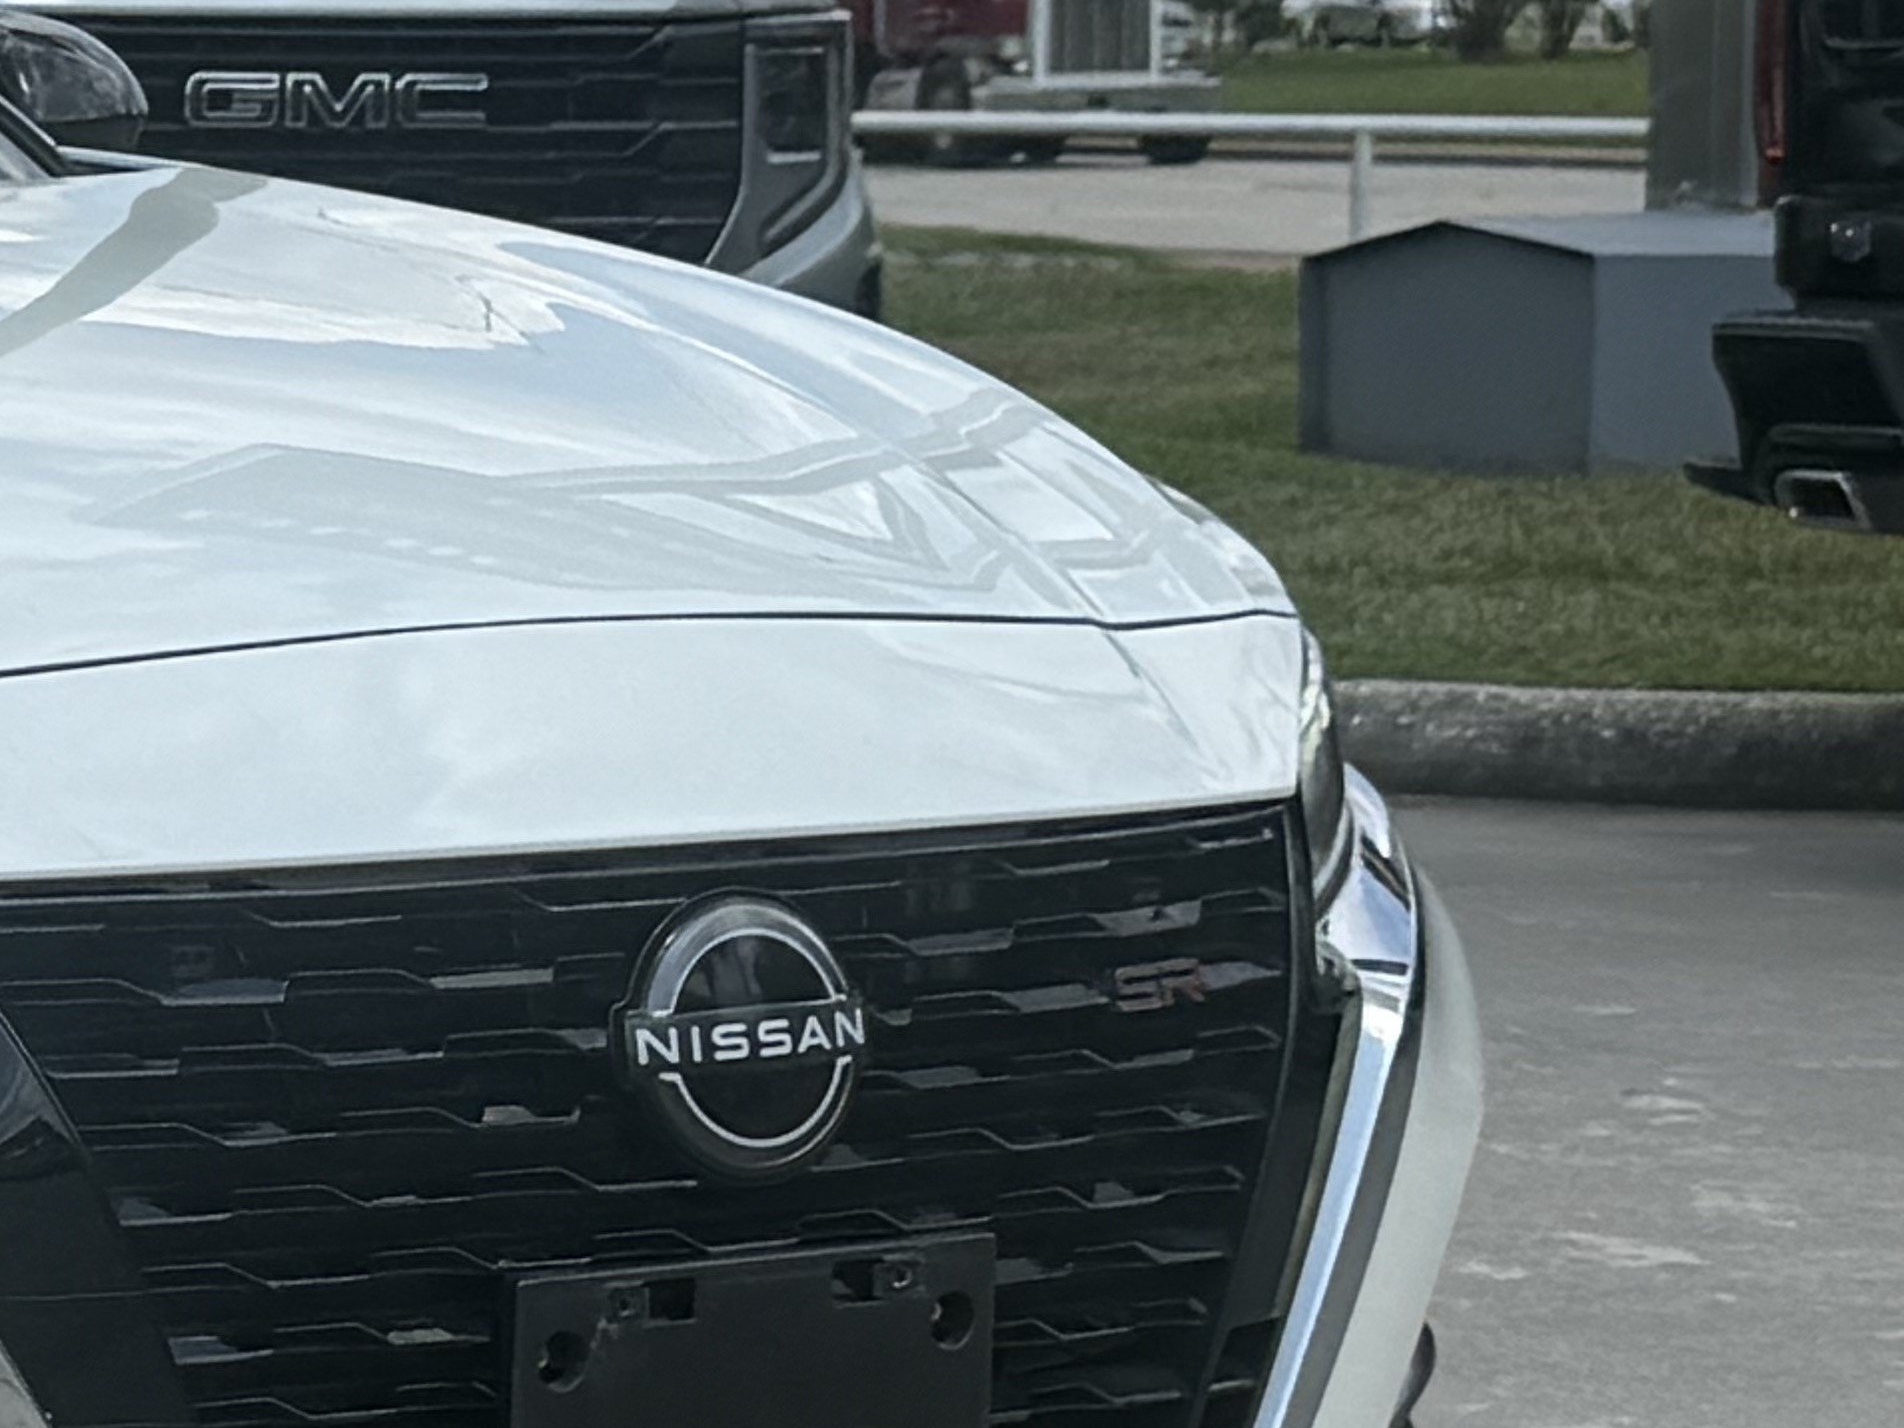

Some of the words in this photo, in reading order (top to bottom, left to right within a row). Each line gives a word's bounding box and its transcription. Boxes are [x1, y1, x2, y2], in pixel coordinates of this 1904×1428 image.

[184, 71, 489, 129] GMC
[1114, 958, 1205, 1012] SR
[635, 1007, 866, 1065] NISSAN
